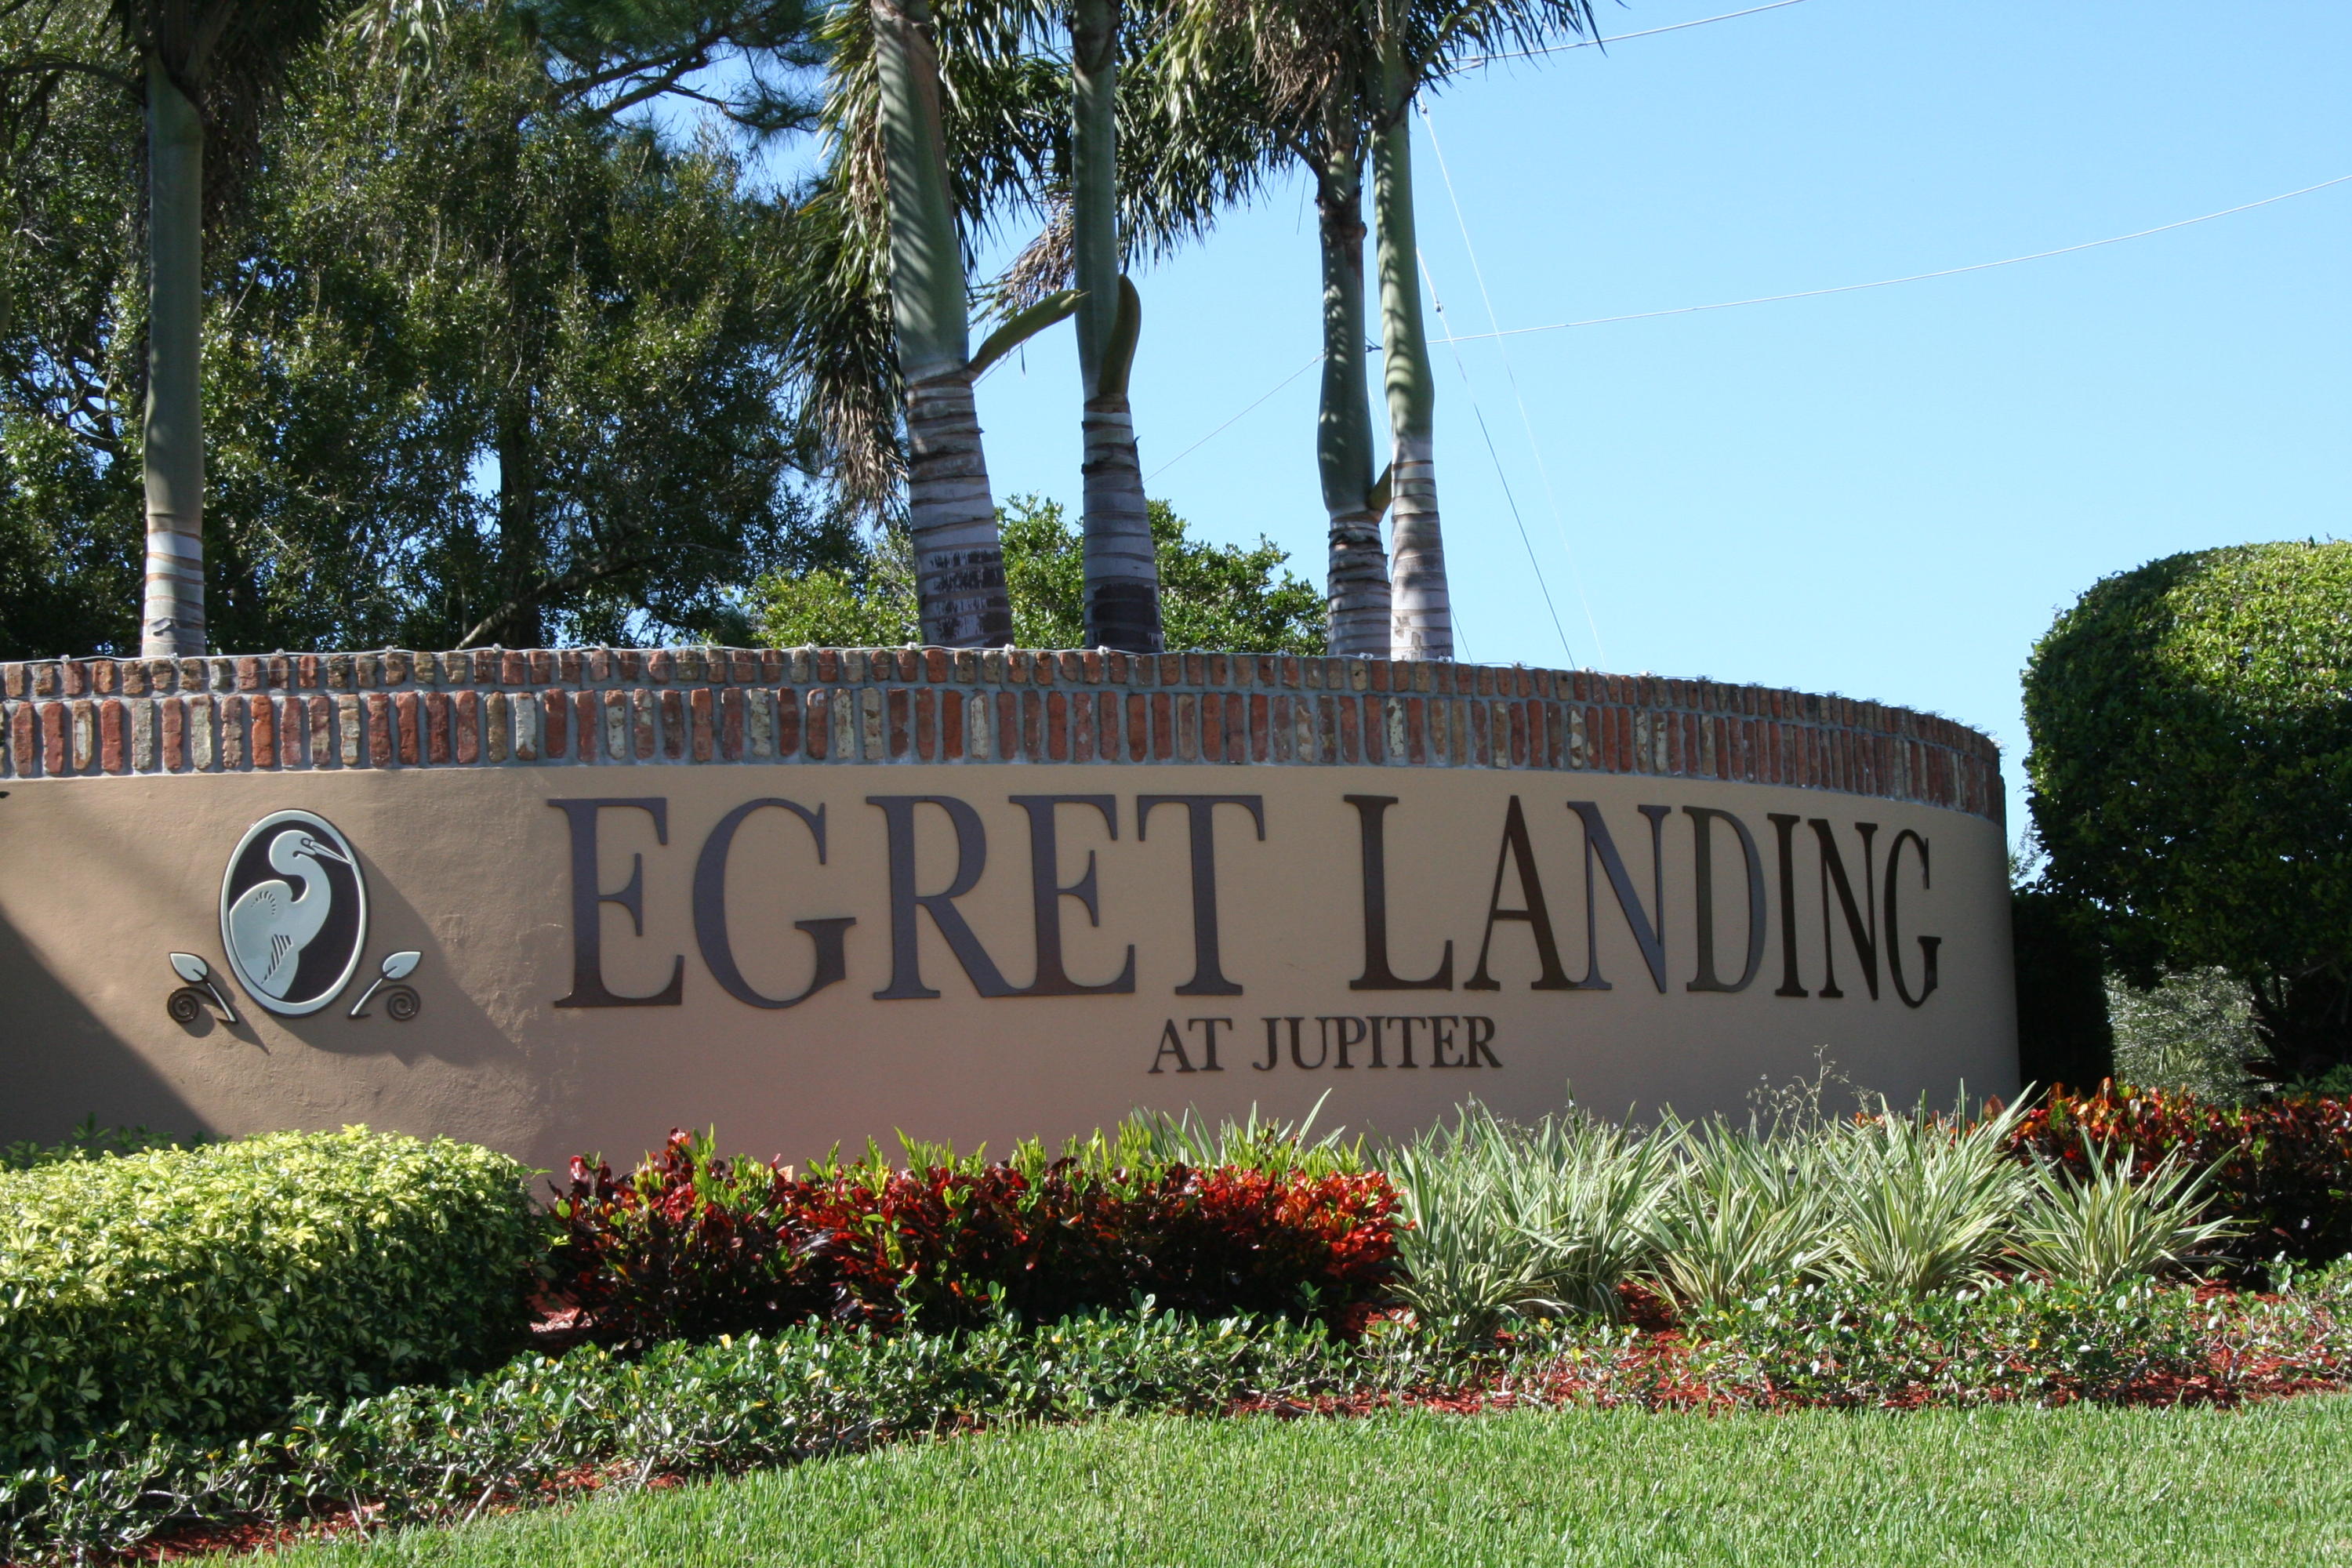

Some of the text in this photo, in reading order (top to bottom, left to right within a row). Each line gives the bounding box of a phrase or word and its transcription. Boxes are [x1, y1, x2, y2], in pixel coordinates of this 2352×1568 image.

[547, 794, 1942, 1009] EGRET LANDING
[1148, 1015, 1503, 1073] AT JUPITER
